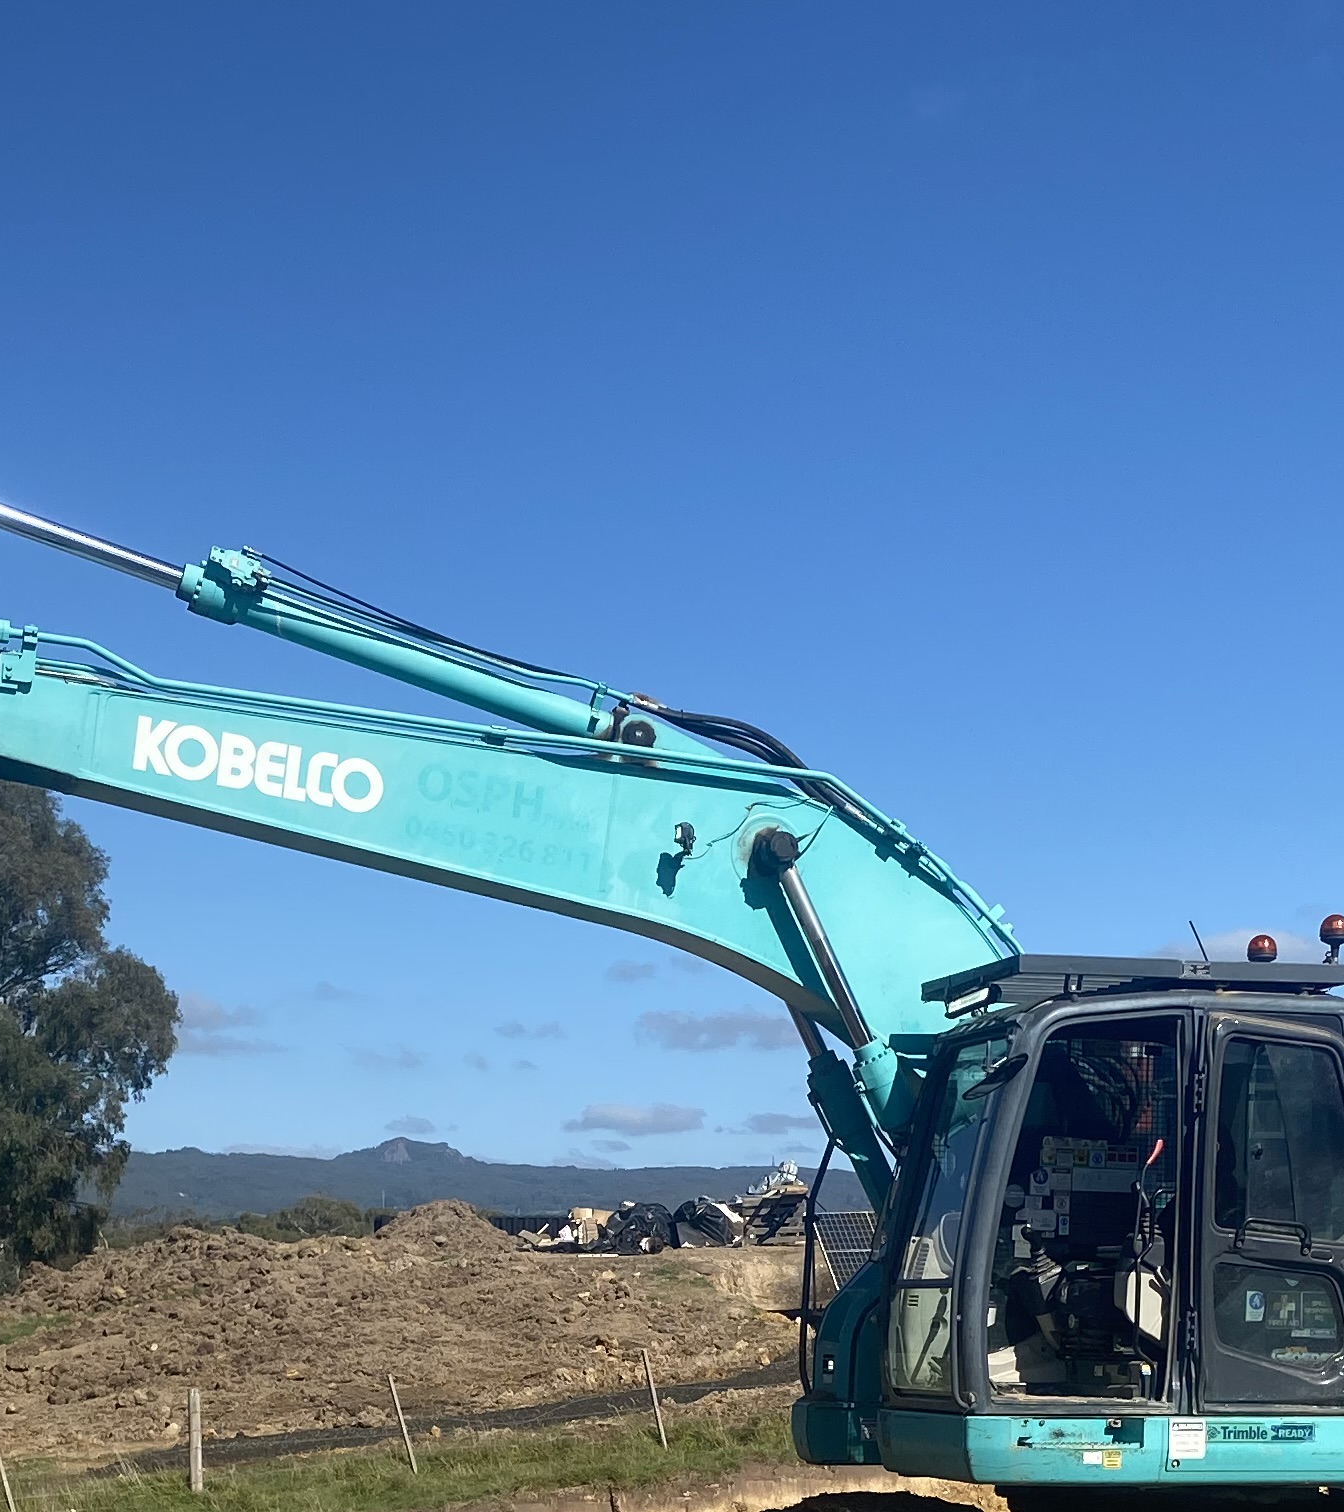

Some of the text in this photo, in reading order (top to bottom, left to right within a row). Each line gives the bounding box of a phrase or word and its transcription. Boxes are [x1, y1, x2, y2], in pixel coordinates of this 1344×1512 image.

[132, 715, 384, 814] KOBELCO
[417, 763, 545, 822] OSPH
[1268, 1318, 1300, 1327] FIRST AID
[1220, 1425, 1312, 1440] Trimble READY
